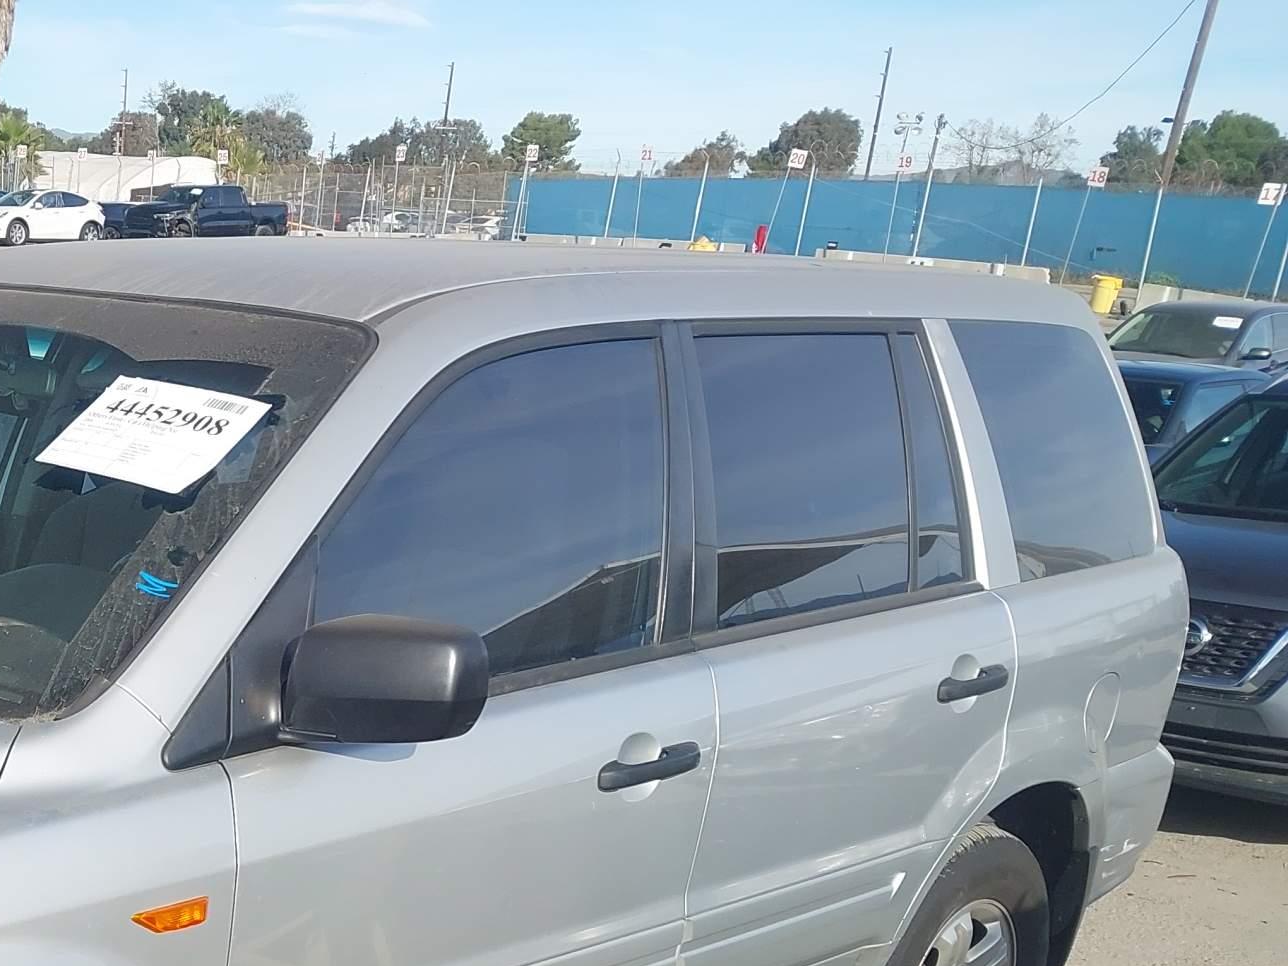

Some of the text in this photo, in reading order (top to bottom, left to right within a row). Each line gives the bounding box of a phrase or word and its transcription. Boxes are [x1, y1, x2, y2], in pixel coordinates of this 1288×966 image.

[527, 148, 538, 158] 22
[642, 150, 652, 160] 21
[790, 152, 805, 165] 20
[898, 156, 912, 168] 19
[1089, 170, 1106, 184] 18
[1261, 188, 1281, 201] 17
[106, 398, 230, 436] 44452908
